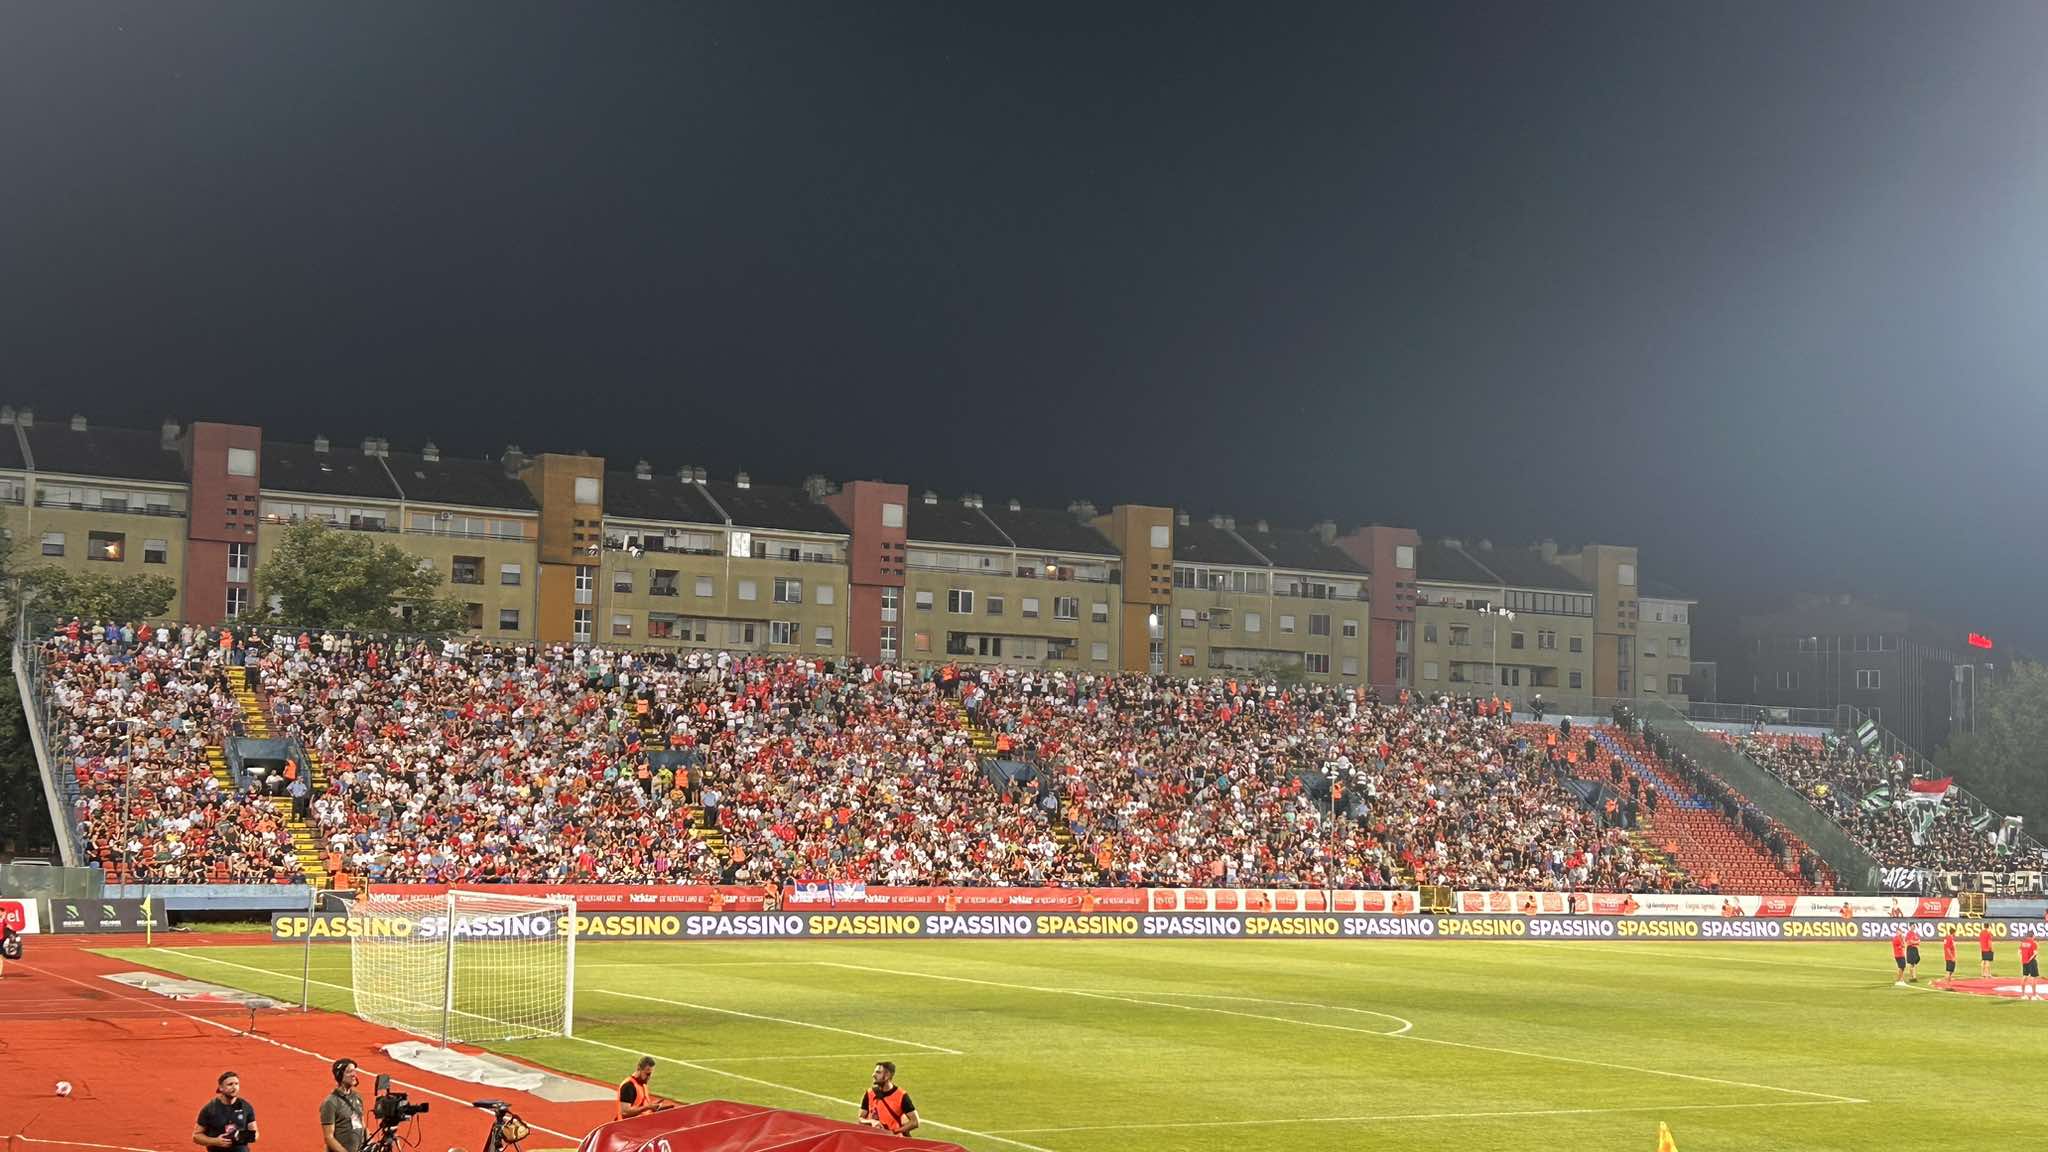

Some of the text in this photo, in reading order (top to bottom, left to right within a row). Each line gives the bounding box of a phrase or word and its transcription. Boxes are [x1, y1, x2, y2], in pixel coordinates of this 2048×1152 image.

[275, 917, 412, 938] SPASSINO
[419, 916, 551, 937] SPASSINO
[557, 915, 681, 936] SPASSINO
[686, 915, 804, 935] SPASSINO
[808, 915, 921, 935] SPASSINO
[926, 915, 1033, 934] SPASSINO
[1036, 915, 1139, 935] SPASSINO
[1143, 916, 1241, 935] SPASSINO
[1245, 917, 1340, 936] SPASSINO
[1343, 918, 1434, 936] SPASSINO
[1438, 918, 1526, 936] SPASSINO
[1529, 919, 1614, 937] SPASSINO
[1617, 919, 1698, 937] SPASSINO
[1702, 920, 1780, 937] SPASSINO
[1783, 921, 1859, 937] SPASSINO
